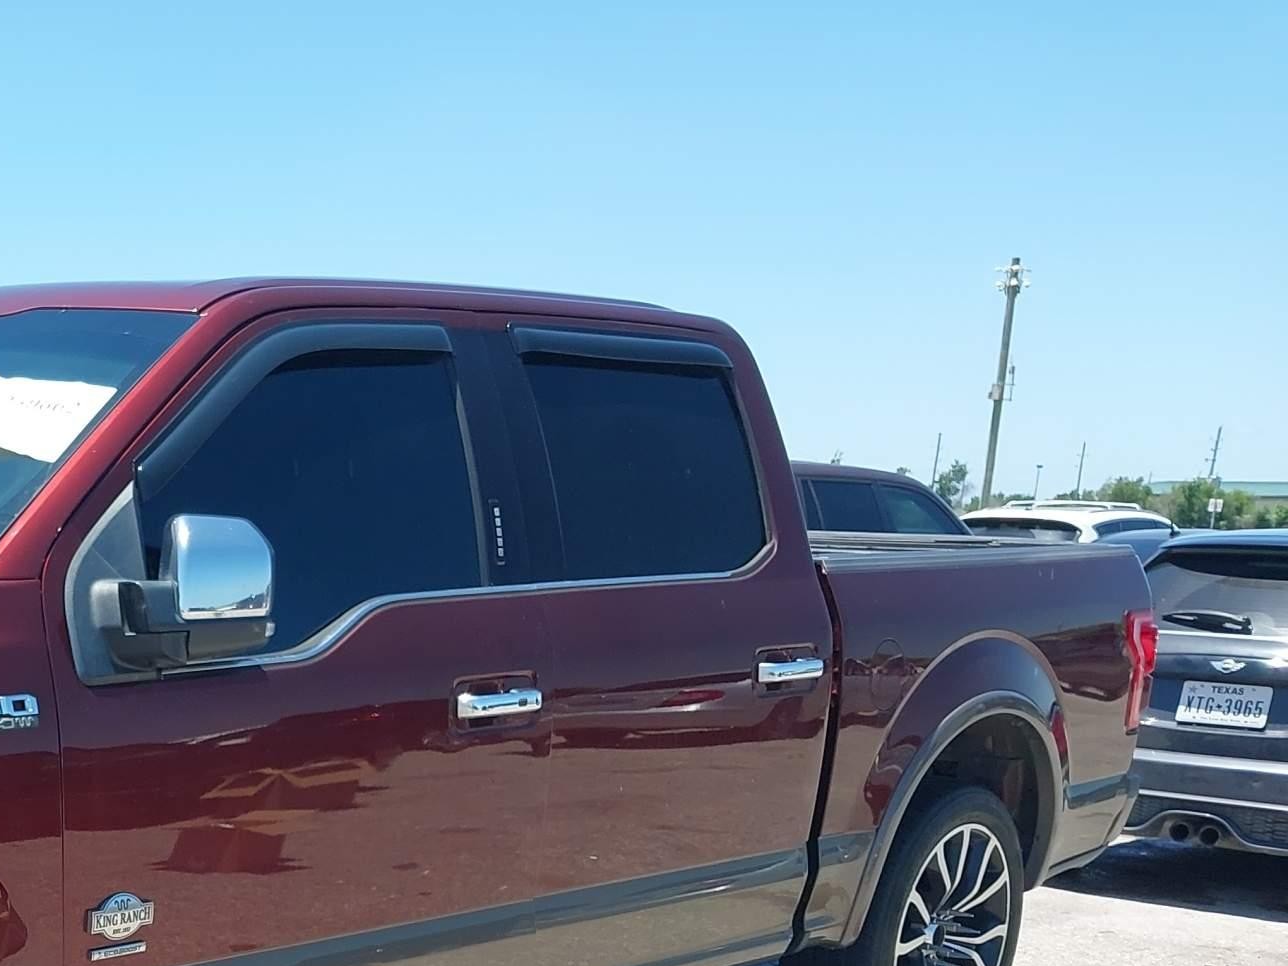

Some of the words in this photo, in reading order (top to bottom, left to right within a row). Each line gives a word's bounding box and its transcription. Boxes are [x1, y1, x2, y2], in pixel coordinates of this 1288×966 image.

[1211, 686, 1244, 696] TEXAS
[96, 913, 118, 929] KING
[121, 907, 150, 924] RANCH
